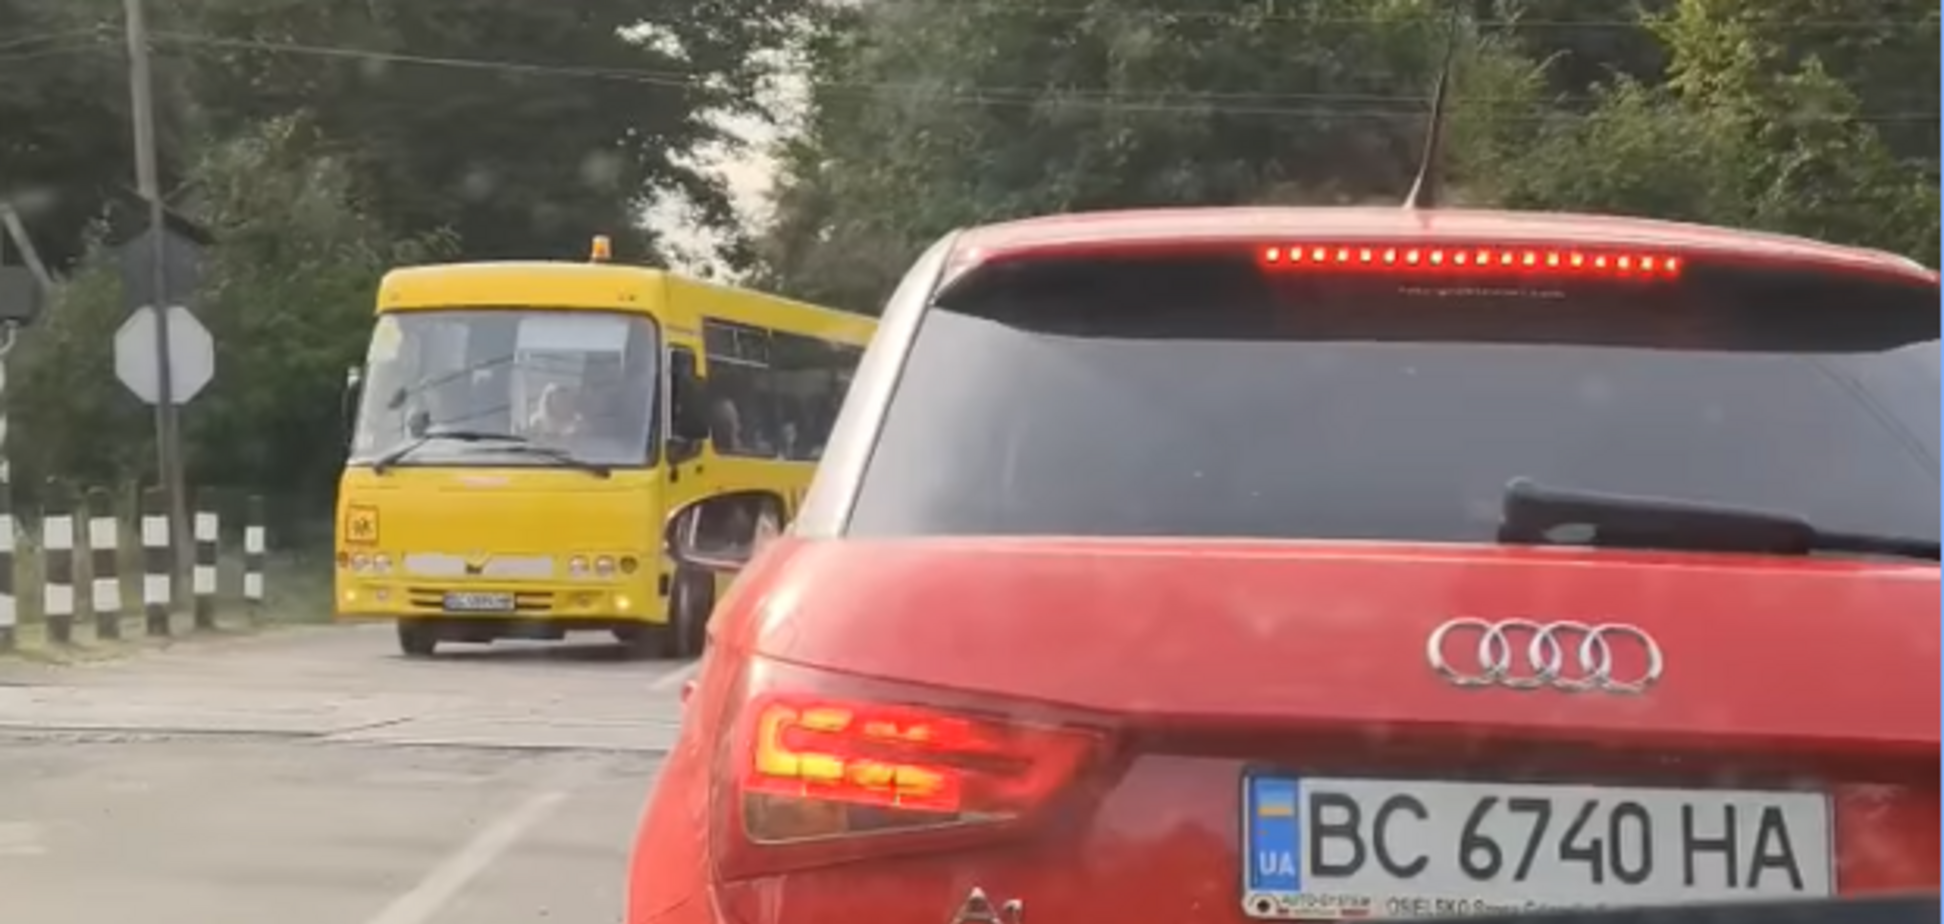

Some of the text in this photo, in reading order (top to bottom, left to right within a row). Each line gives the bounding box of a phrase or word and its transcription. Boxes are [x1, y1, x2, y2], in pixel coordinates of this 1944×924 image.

[1258, 851, 1296, 876] UA
[1309, 791, 1805, 891] BC 6740 HA
